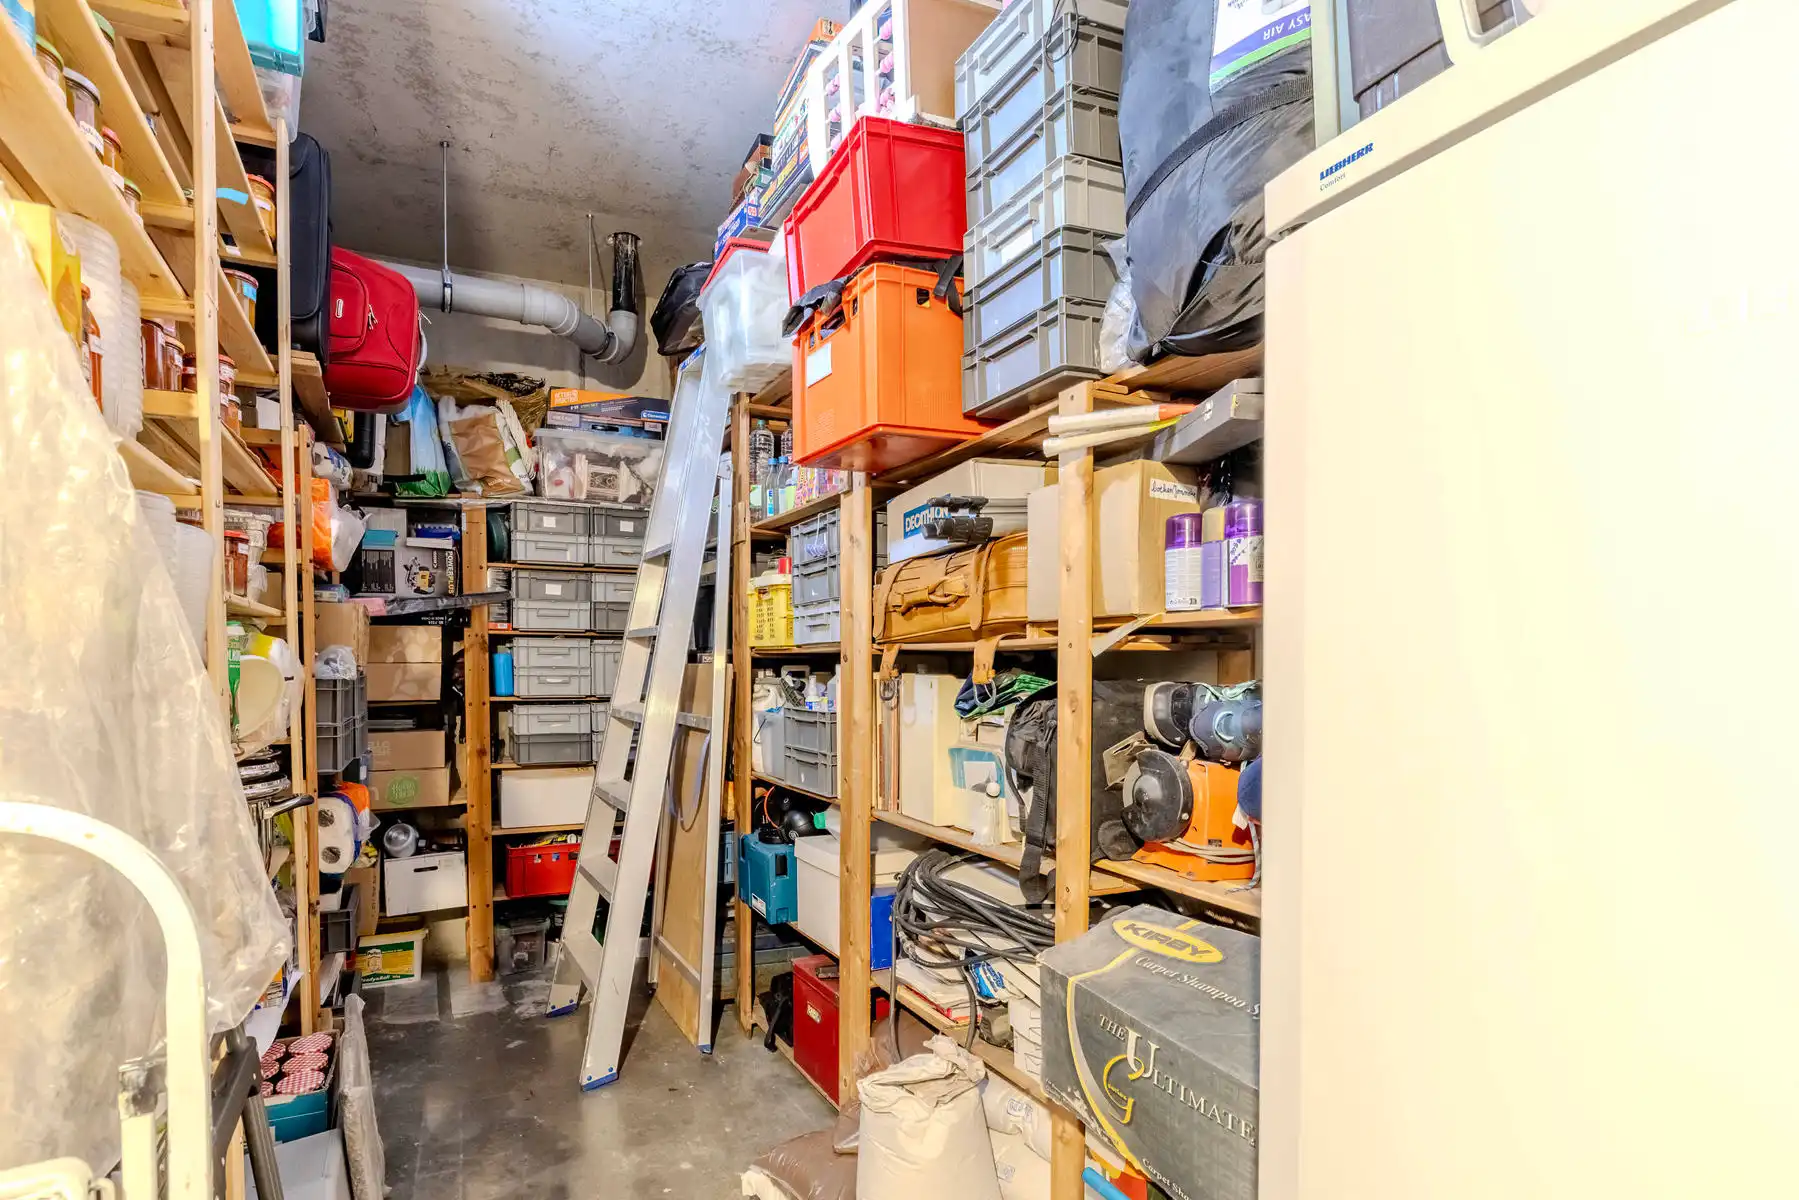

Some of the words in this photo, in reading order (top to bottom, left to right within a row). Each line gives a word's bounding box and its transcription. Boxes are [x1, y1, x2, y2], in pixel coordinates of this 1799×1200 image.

[1263, 22, 1285, 40] AIR
[1287, 12, 1311, 30] ASY
[1319, 142, 1374, 181] LIEBHERR
[1319, 172, 1346, 191] Comfort
[446, 550, 455, 595] POWERPLUS
[1122, 922, 1213, 957] KIRBY
[1135, 956, 1178, 979] Carpet
[1177, 974, 1247, 1009] Shampoo
[1099, 1014, 1126, 1041] THE
[1125, 1026, 1257, 1148] ULTIMATE
[1142, 1157, 1170, 1186] Carpet
